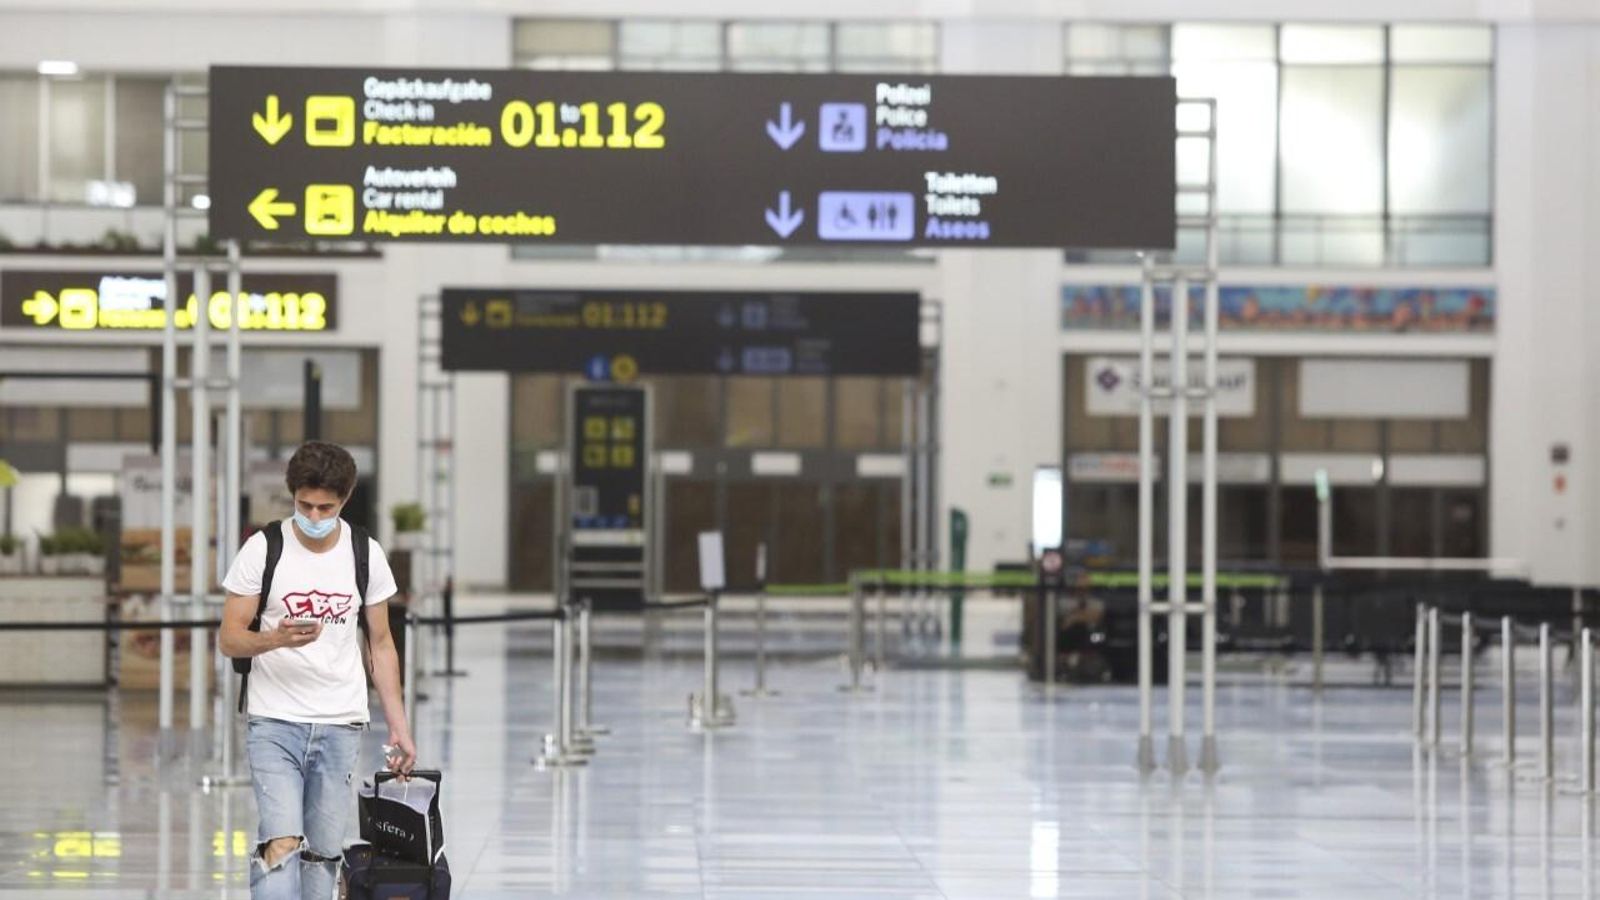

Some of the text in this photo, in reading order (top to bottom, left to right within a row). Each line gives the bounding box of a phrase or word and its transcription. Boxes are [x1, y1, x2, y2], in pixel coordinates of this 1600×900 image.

[924, 171, 998, 194] Toiletten
[363, 187, 444, 210] Car rental
[363, 209, 556, 237] Alquiler de coches
[925, 216, 990, 240] Aseos
